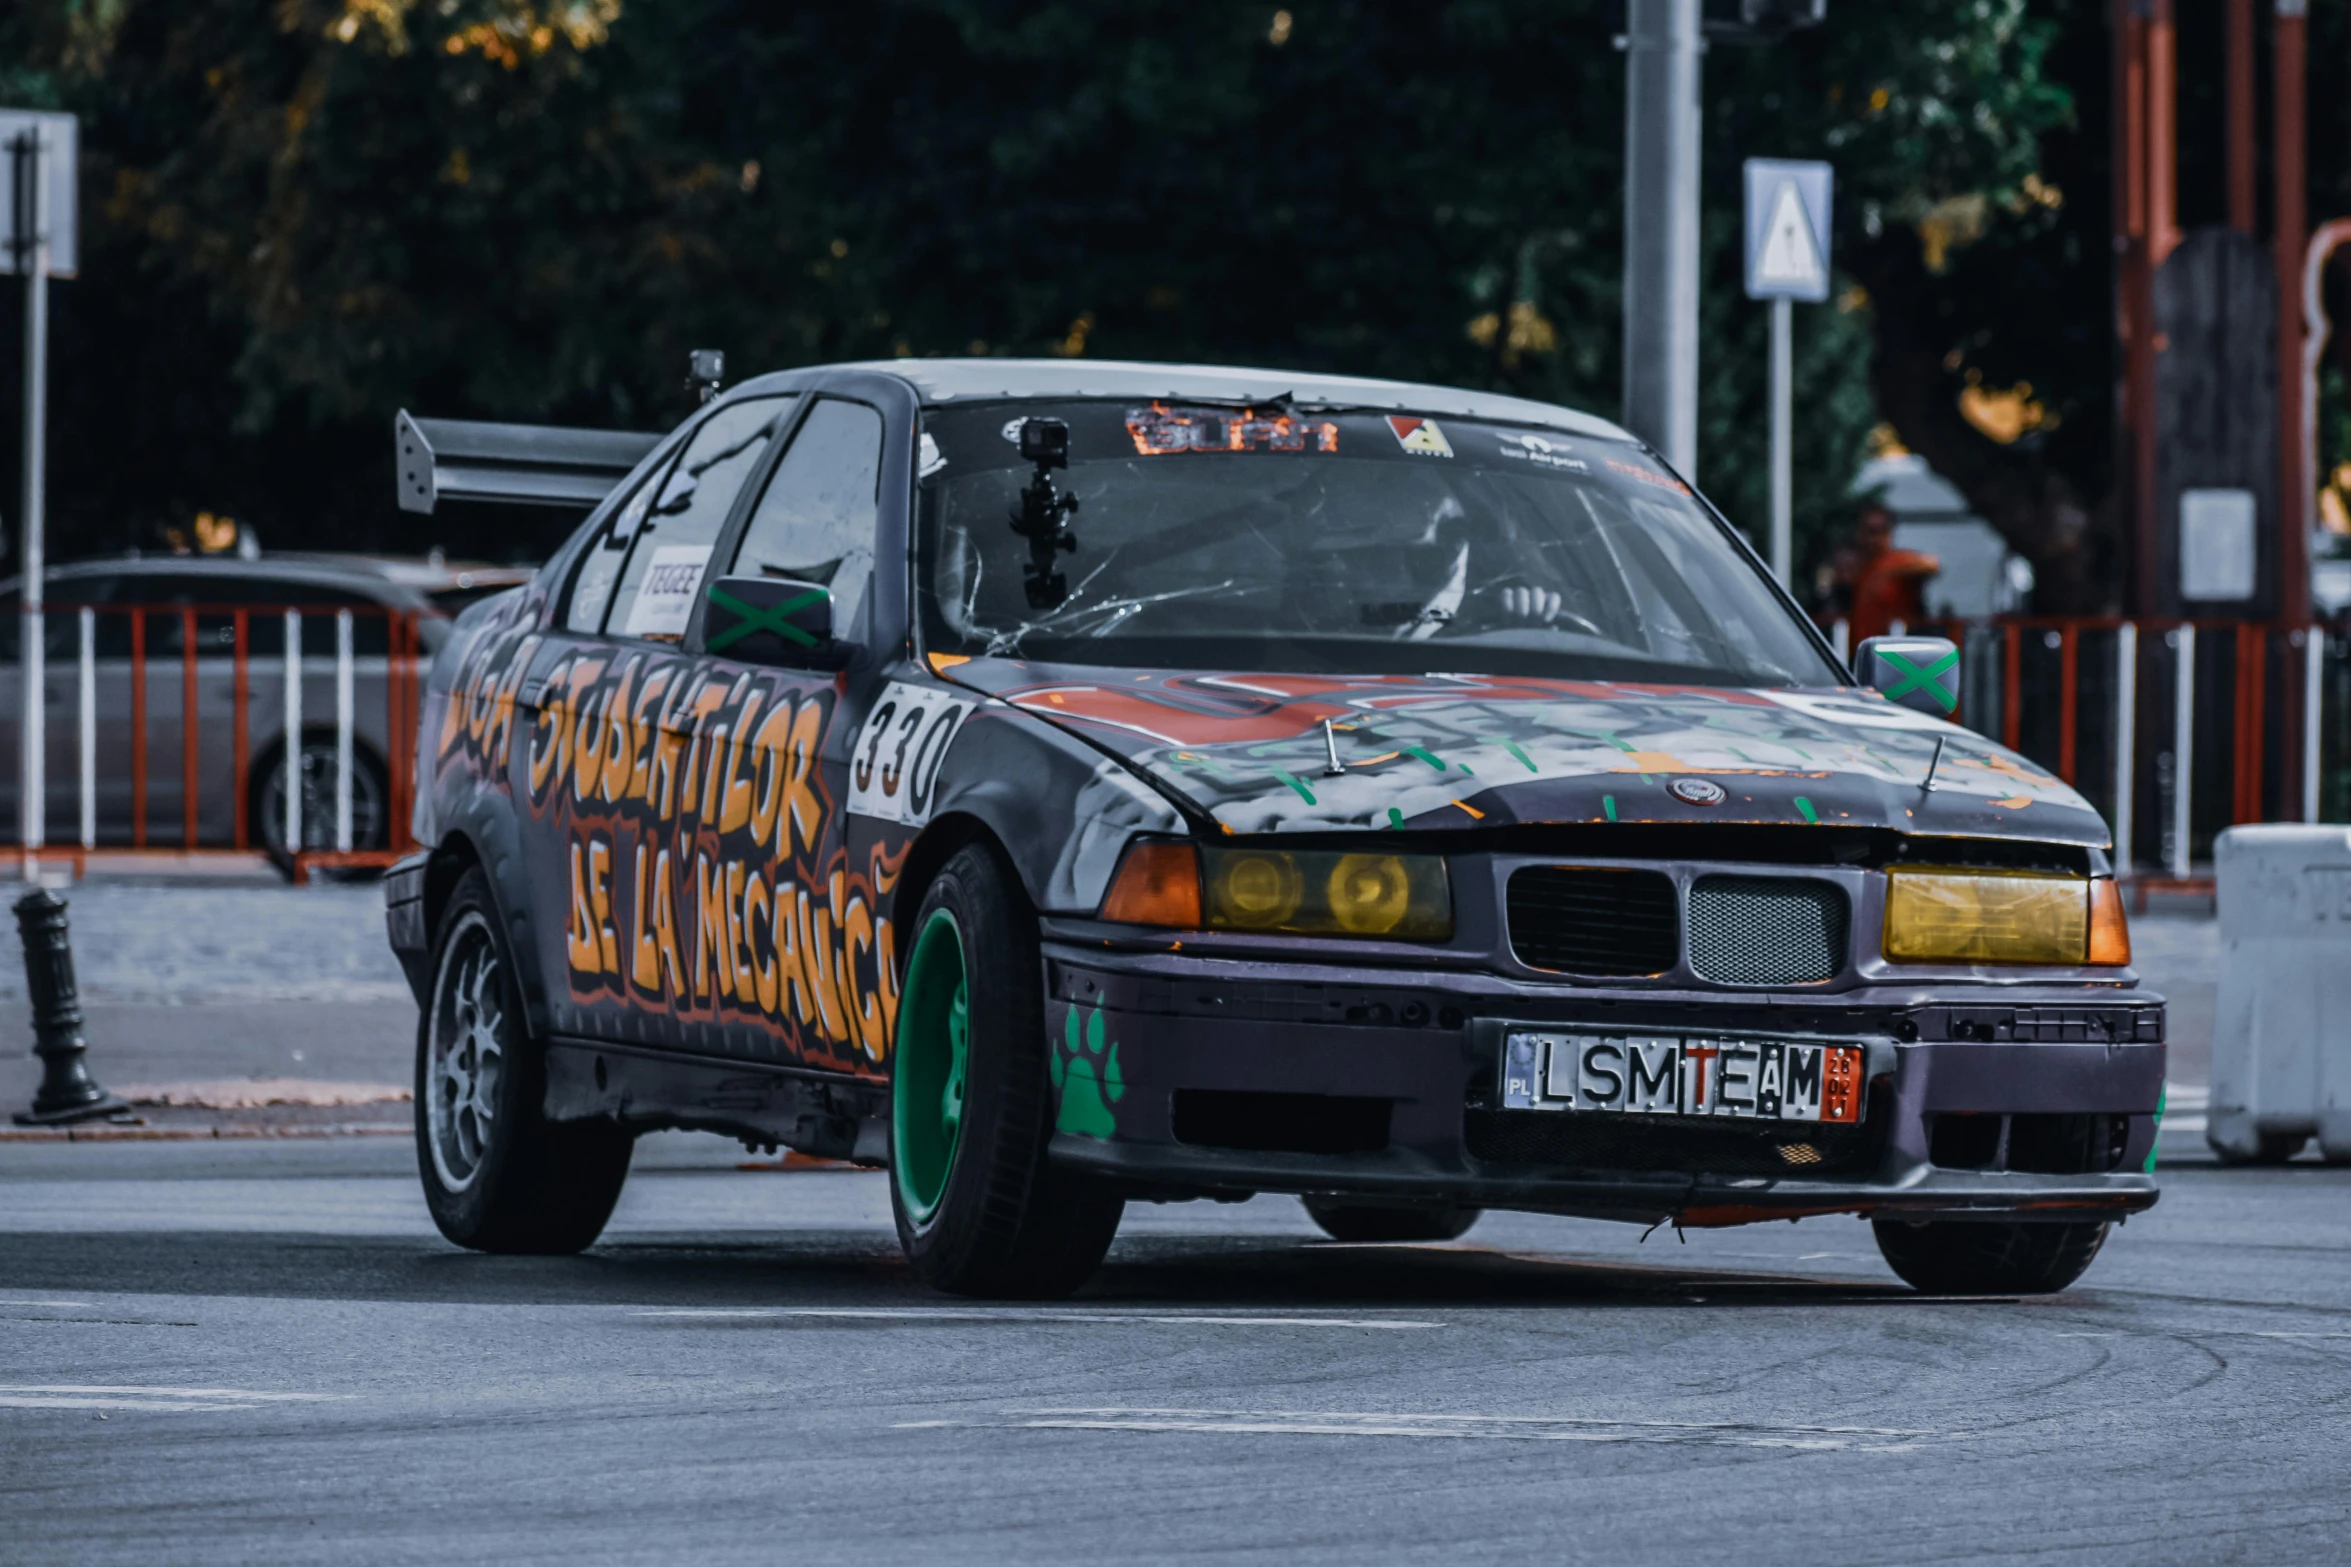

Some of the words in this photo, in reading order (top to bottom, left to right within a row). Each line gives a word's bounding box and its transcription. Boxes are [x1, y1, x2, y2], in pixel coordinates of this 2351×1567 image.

[856, 701, 962, 816] 330
[568, 841, 619, 975] DE
[632, 843, 687, 998] LA
[1508, 1079, 1531, 1097] PL
